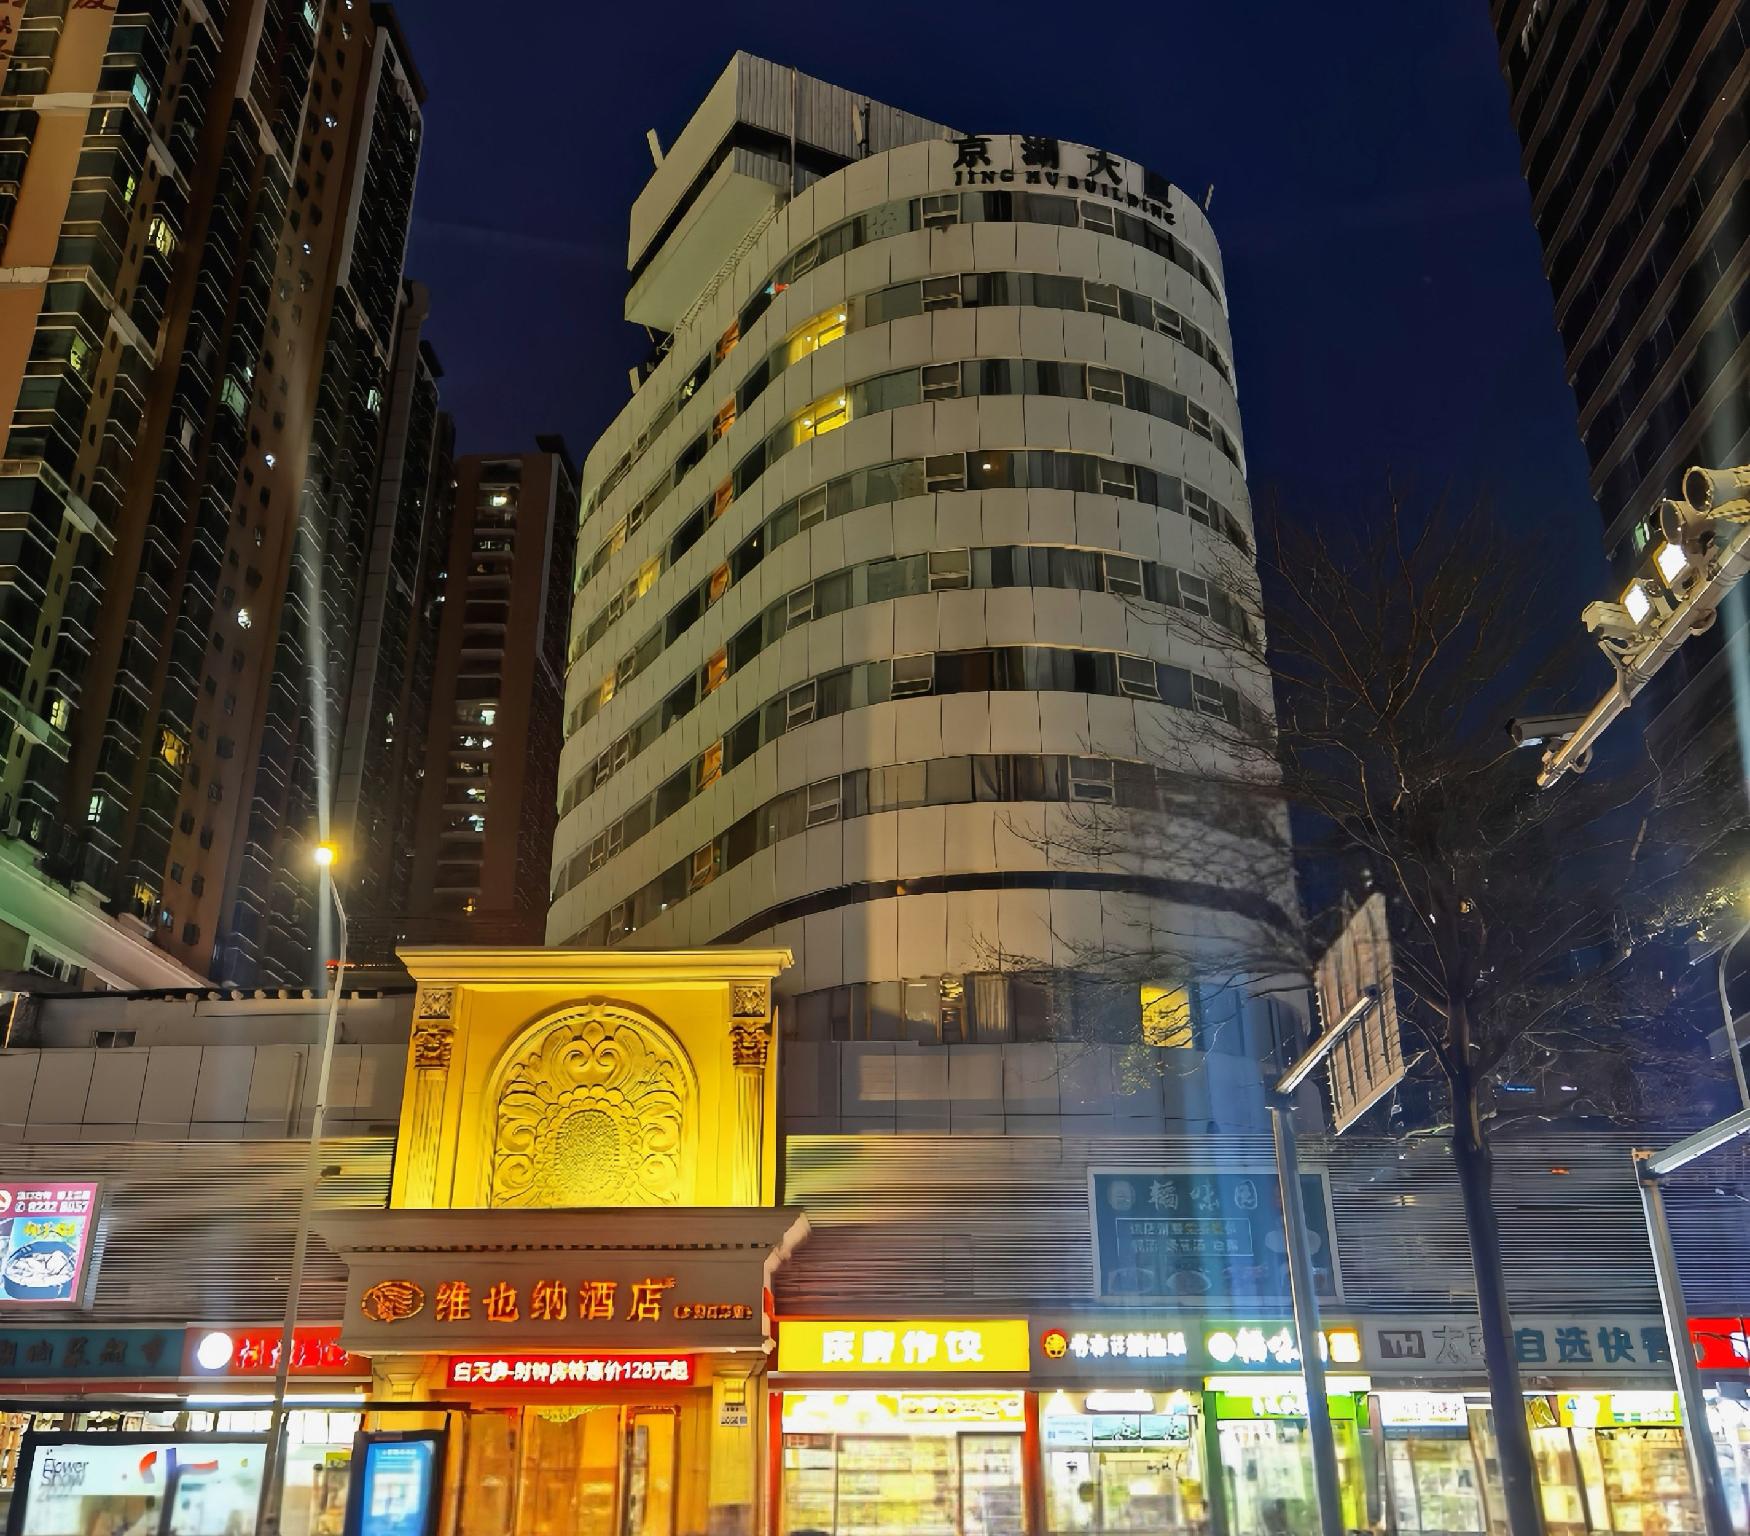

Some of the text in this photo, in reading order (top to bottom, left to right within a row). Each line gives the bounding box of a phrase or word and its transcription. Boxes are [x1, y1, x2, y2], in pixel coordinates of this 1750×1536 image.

[954, 167, 1015, 186] JING
[1067, 176, 1177, 226] BUILDING
[435, 1279, 664, 1323] 维也纳酒店
